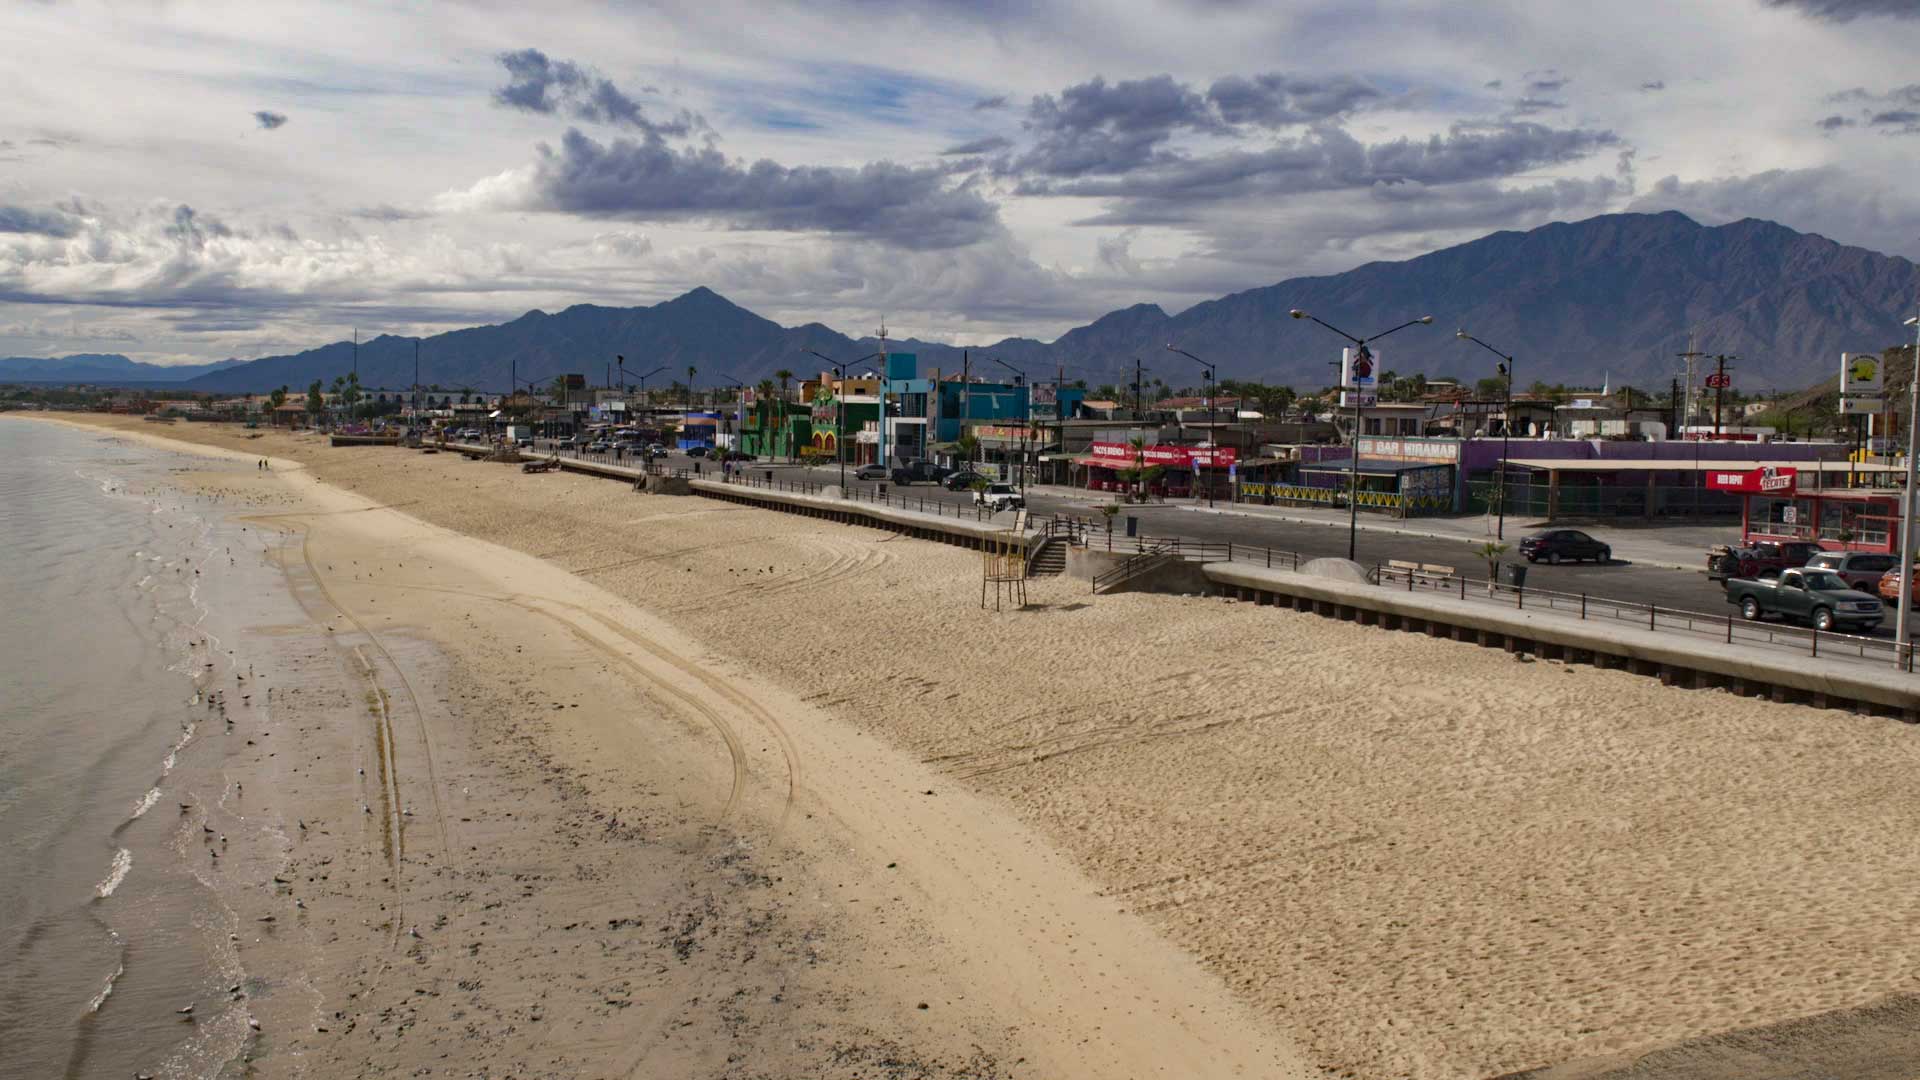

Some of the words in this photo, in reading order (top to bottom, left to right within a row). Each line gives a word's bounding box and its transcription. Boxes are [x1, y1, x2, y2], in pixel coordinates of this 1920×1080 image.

[1376, 441, 1399, 455] BAR
[1404, 443, 1456, 459] MIRAMAR
[1762, 478, 1788, 490] TECATE
